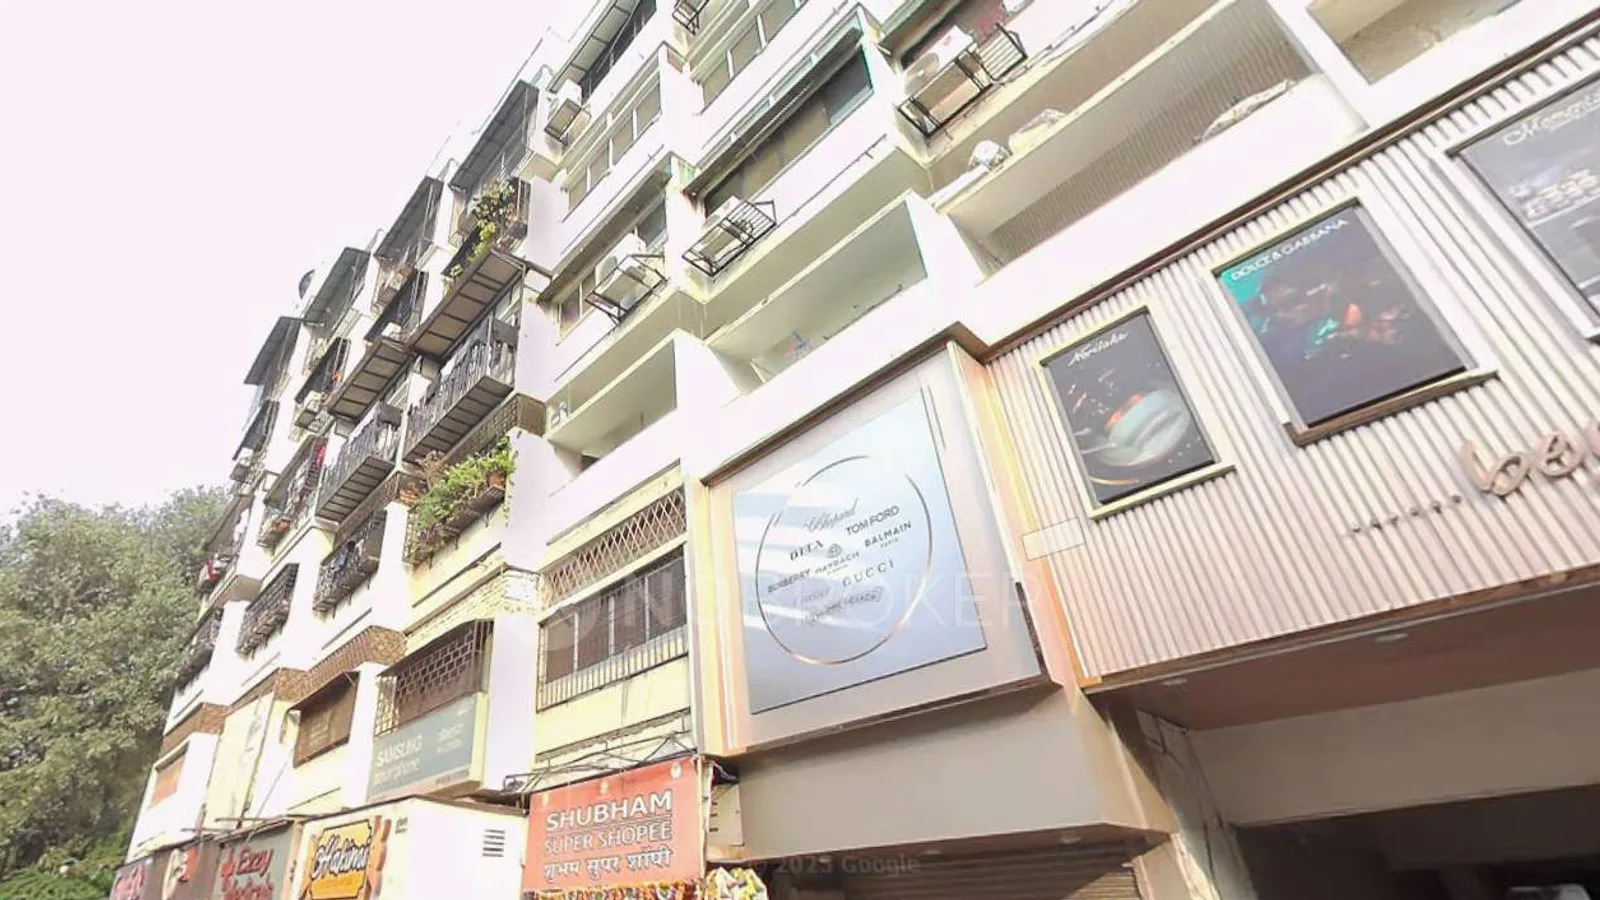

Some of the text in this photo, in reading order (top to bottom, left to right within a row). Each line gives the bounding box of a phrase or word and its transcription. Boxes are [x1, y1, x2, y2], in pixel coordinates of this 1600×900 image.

[1231, 255, 1273, 281] DOLCE
[1272, 250, 1283, 261] &
[864, 521, 912, 548] BALMAIN
[842, 558, 894, 587] GUCCI
[546, 789, 673, 832] SHUBHAM
[545, 818, 673, 855] SUPER SHOPEE
[587, 856, 621, 879] सुपर
